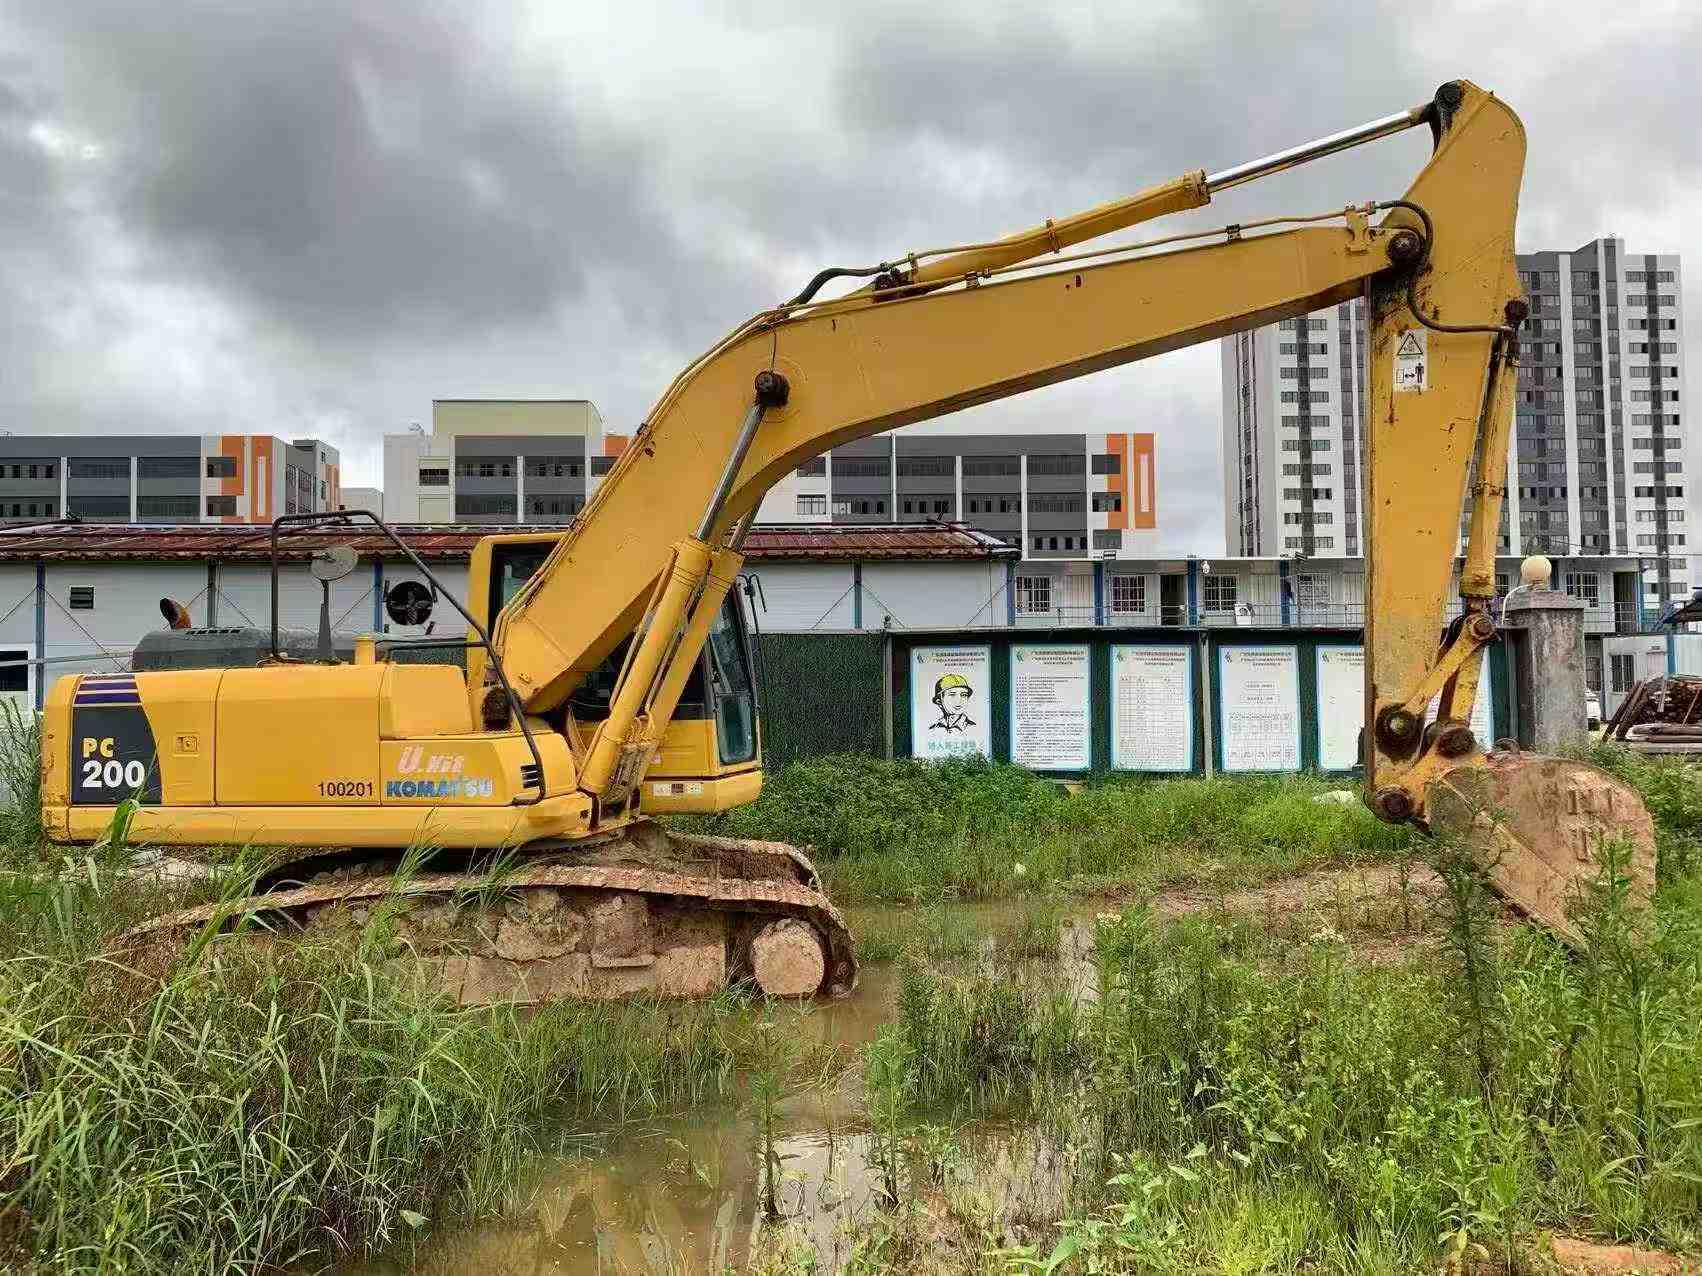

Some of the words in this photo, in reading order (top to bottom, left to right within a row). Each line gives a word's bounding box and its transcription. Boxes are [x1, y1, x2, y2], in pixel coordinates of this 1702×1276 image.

[82, 737, 114, 758] PC
[82, 760, 146, 788] 200
[318, 782, 374, 797] 100201
